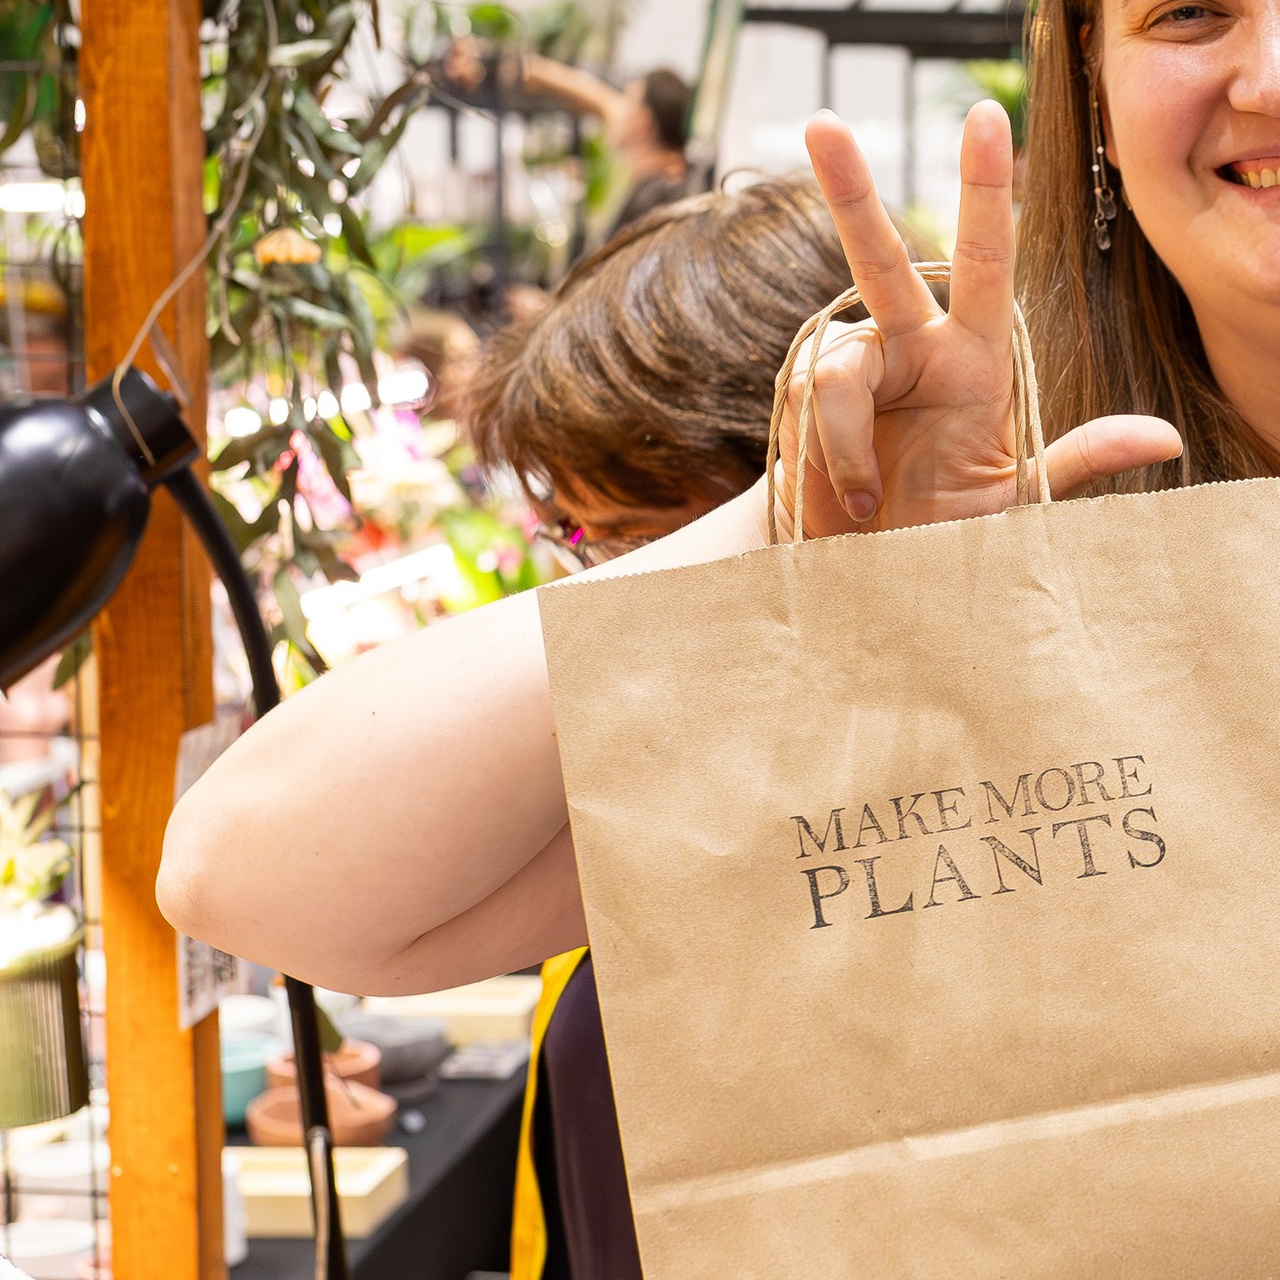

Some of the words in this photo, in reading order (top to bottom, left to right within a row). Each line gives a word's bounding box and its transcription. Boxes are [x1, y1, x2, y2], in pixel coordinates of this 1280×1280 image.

[790, 787, 972, 860] MAKE
[979, 755, 1153, 824] MORE
[800, 807, 1167, 930] PLANTS
